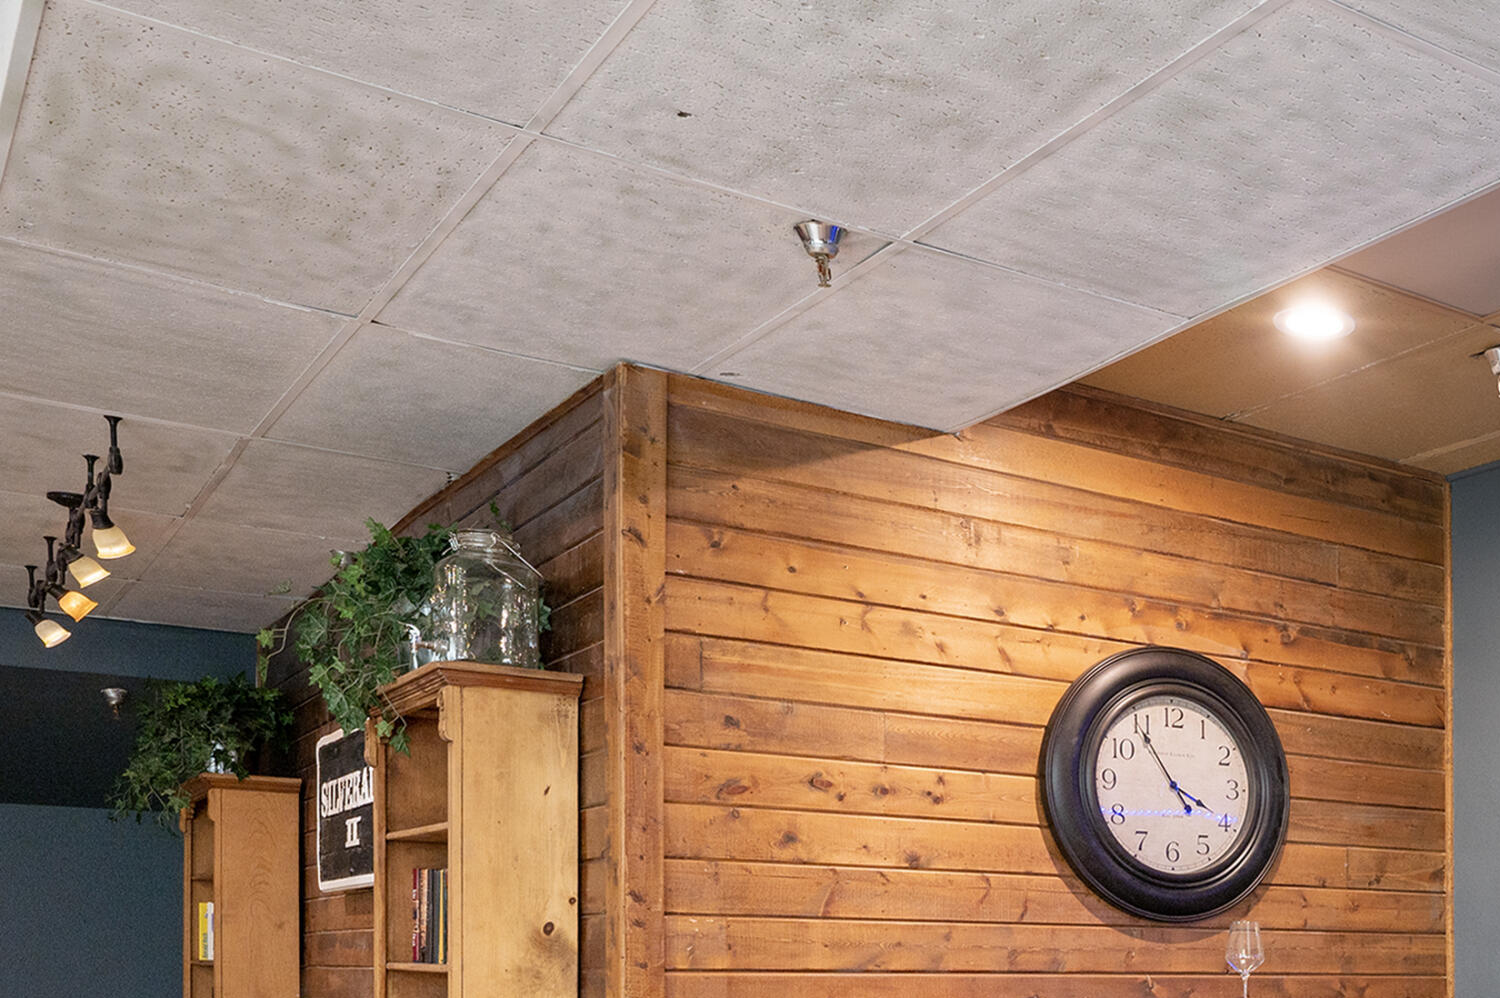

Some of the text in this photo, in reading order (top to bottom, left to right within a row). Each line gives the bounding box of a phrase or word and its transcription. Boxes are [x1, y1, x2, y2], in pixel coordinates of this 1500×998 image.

[1133, 713, 1150, 735] 11
[1164, 707, 1184, 729] 12
[1199, 719, 1207, 740] 1
[1112, 737, 1135, 760] 10
[1218, 745, 1232, 767] 2
[1101, 768, 1117, 790] 9
[1225, 779, 1239, 801] 3
[321, 766, 374, 818] SILVERA
[1110, 803, 1126, 825] 8
[1218, 812, 1232, 832] 4
[344, 816, 362, 848] II
[1135, 831, 1149, 851] 7
[1165, 841, 1181, 863] 6
[1196, 835, 1211, 856] 5
